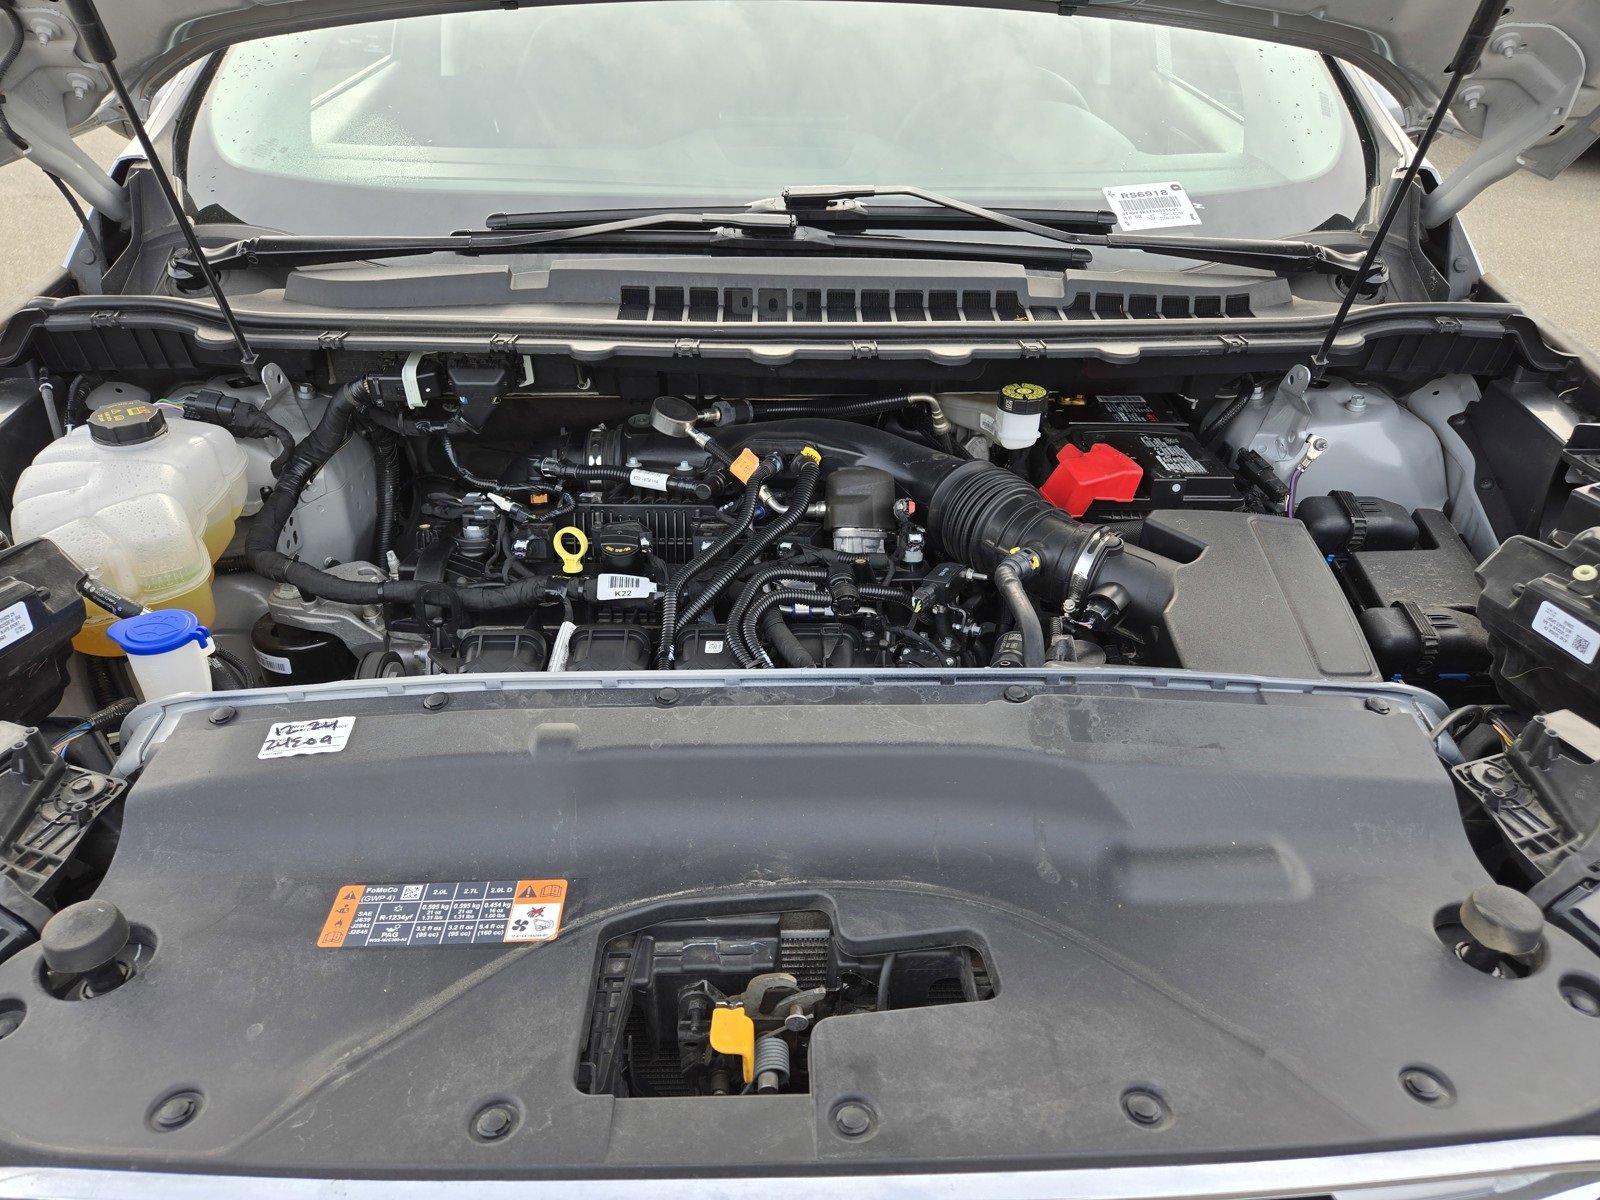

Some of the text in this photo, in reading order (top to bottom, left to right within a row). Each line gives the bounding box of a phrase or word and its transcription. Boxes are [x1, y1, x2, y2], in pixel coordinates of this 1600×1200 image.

[1120, 189, 1169, 199] RS6918
[366, 886, 399, 894] FoMoCo
[361, 895, 396, 903] (GWP 4)
[440, 903, 450, 911] kg
[502, 901, 511, 909] kg
[379, 913, 414, 921] R-1234yf
